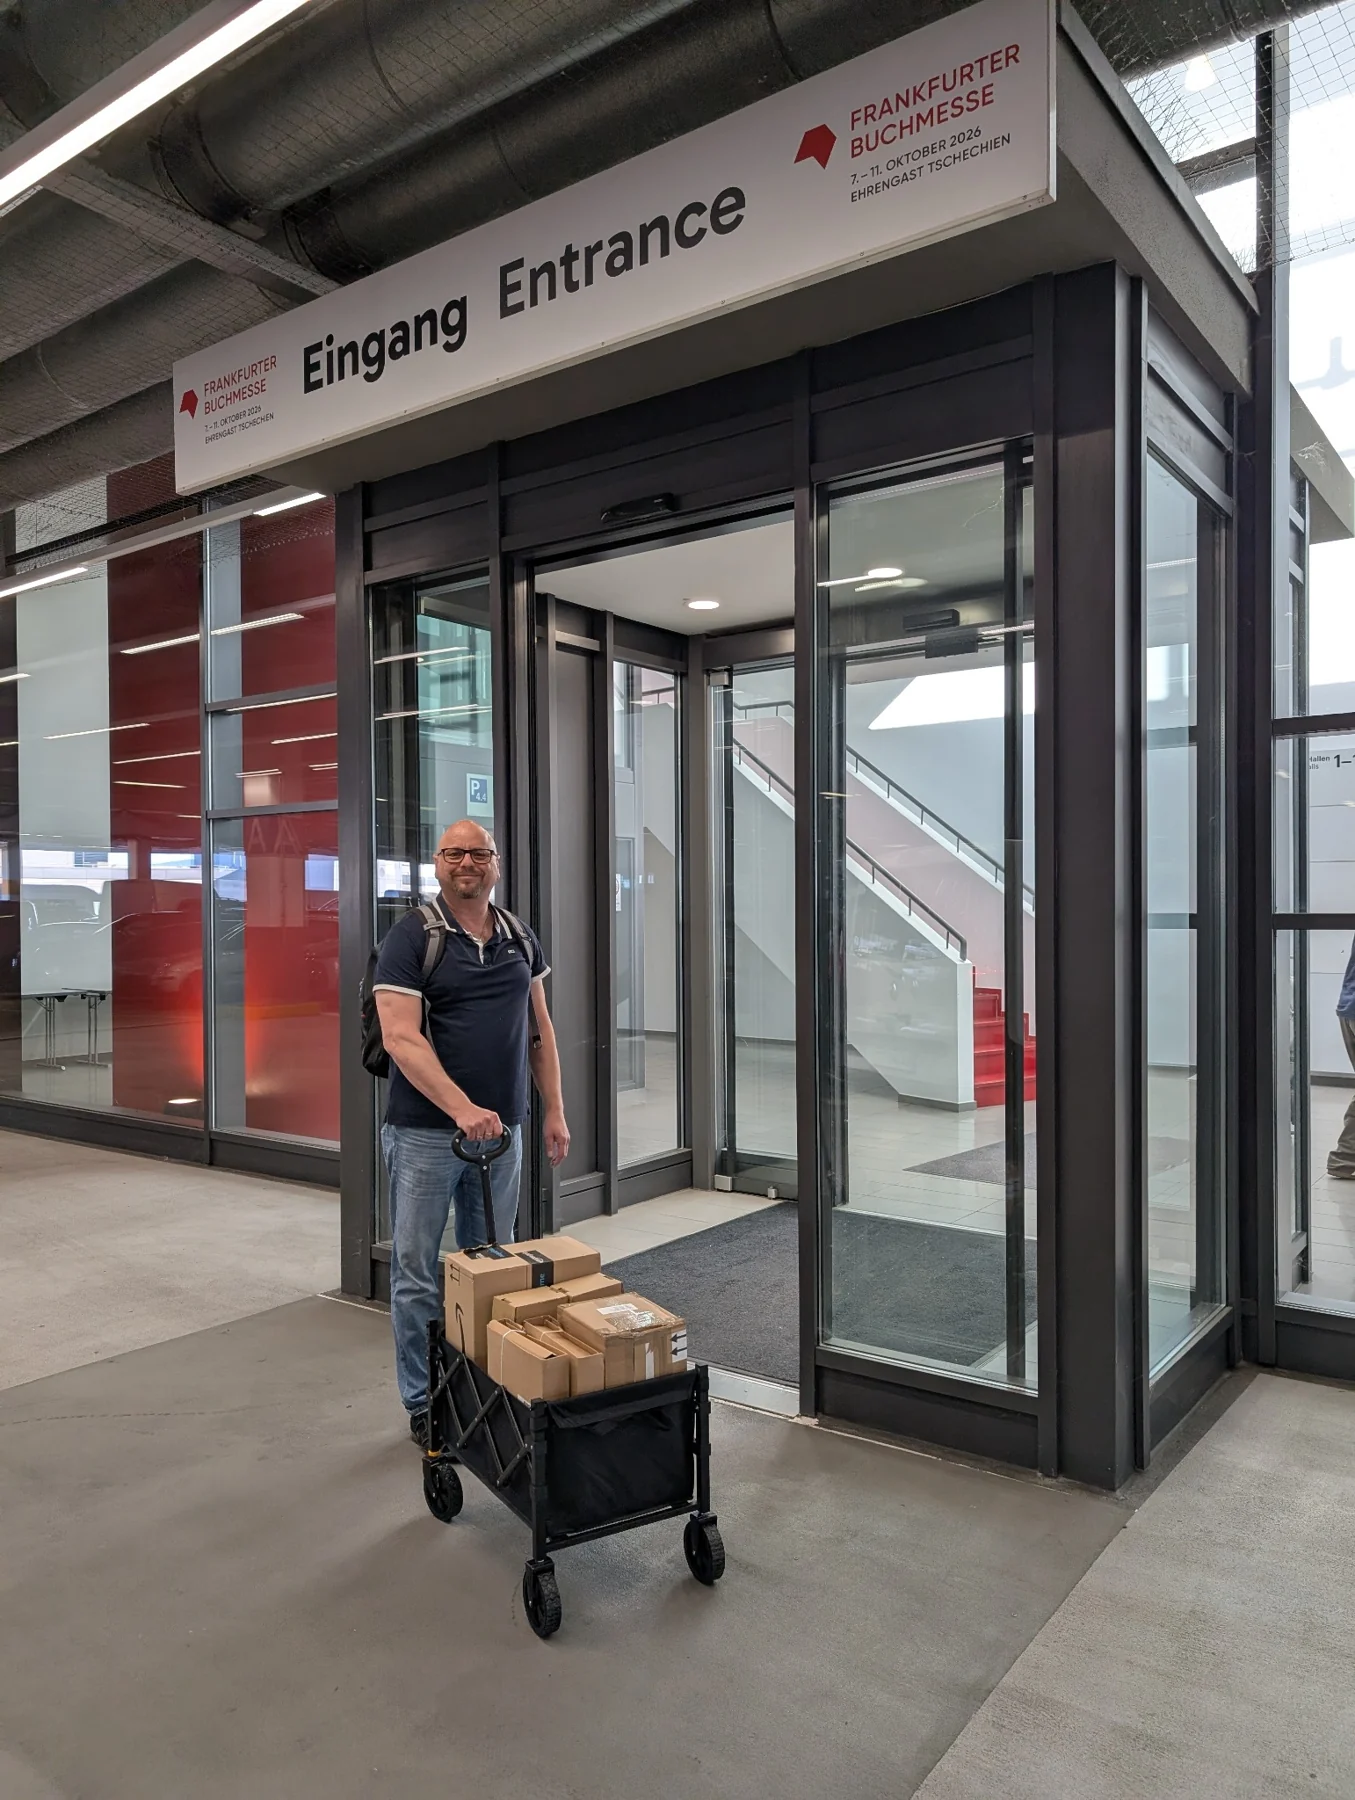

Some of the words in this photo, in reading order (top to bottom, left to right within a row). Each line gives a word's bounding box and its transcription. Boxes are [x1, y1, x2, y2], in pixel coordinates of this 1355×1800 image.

[850, 43, 1020, 131] FRANKFURTER
[850, 83, 994, 159] BUCHMESSE
[851, 165, 924, 203] EHRENGAST
[927, 132, 1011, 173] TSCHECHIEN
[886, 138, 947, 171] OKTOBER
[950, 125, 982, 148] 2026
[303, 295, 468, 395] Eingang
[499, 186, 747, 320] Entrance
[204, 355, 277, 397] FRANKFURTER
[204, 378, 266, 415] BUCHMESSE
[205, 425, 237, 444] EHRENGAST
[237, 412, 274, 432] TSCHECHIEN
[220, 410, 247, 427] OKTOBER
[247, 404, 262, 417] 2026
[471, 780, 480, 796] P
[475, 792, 487, 802] 4.4
